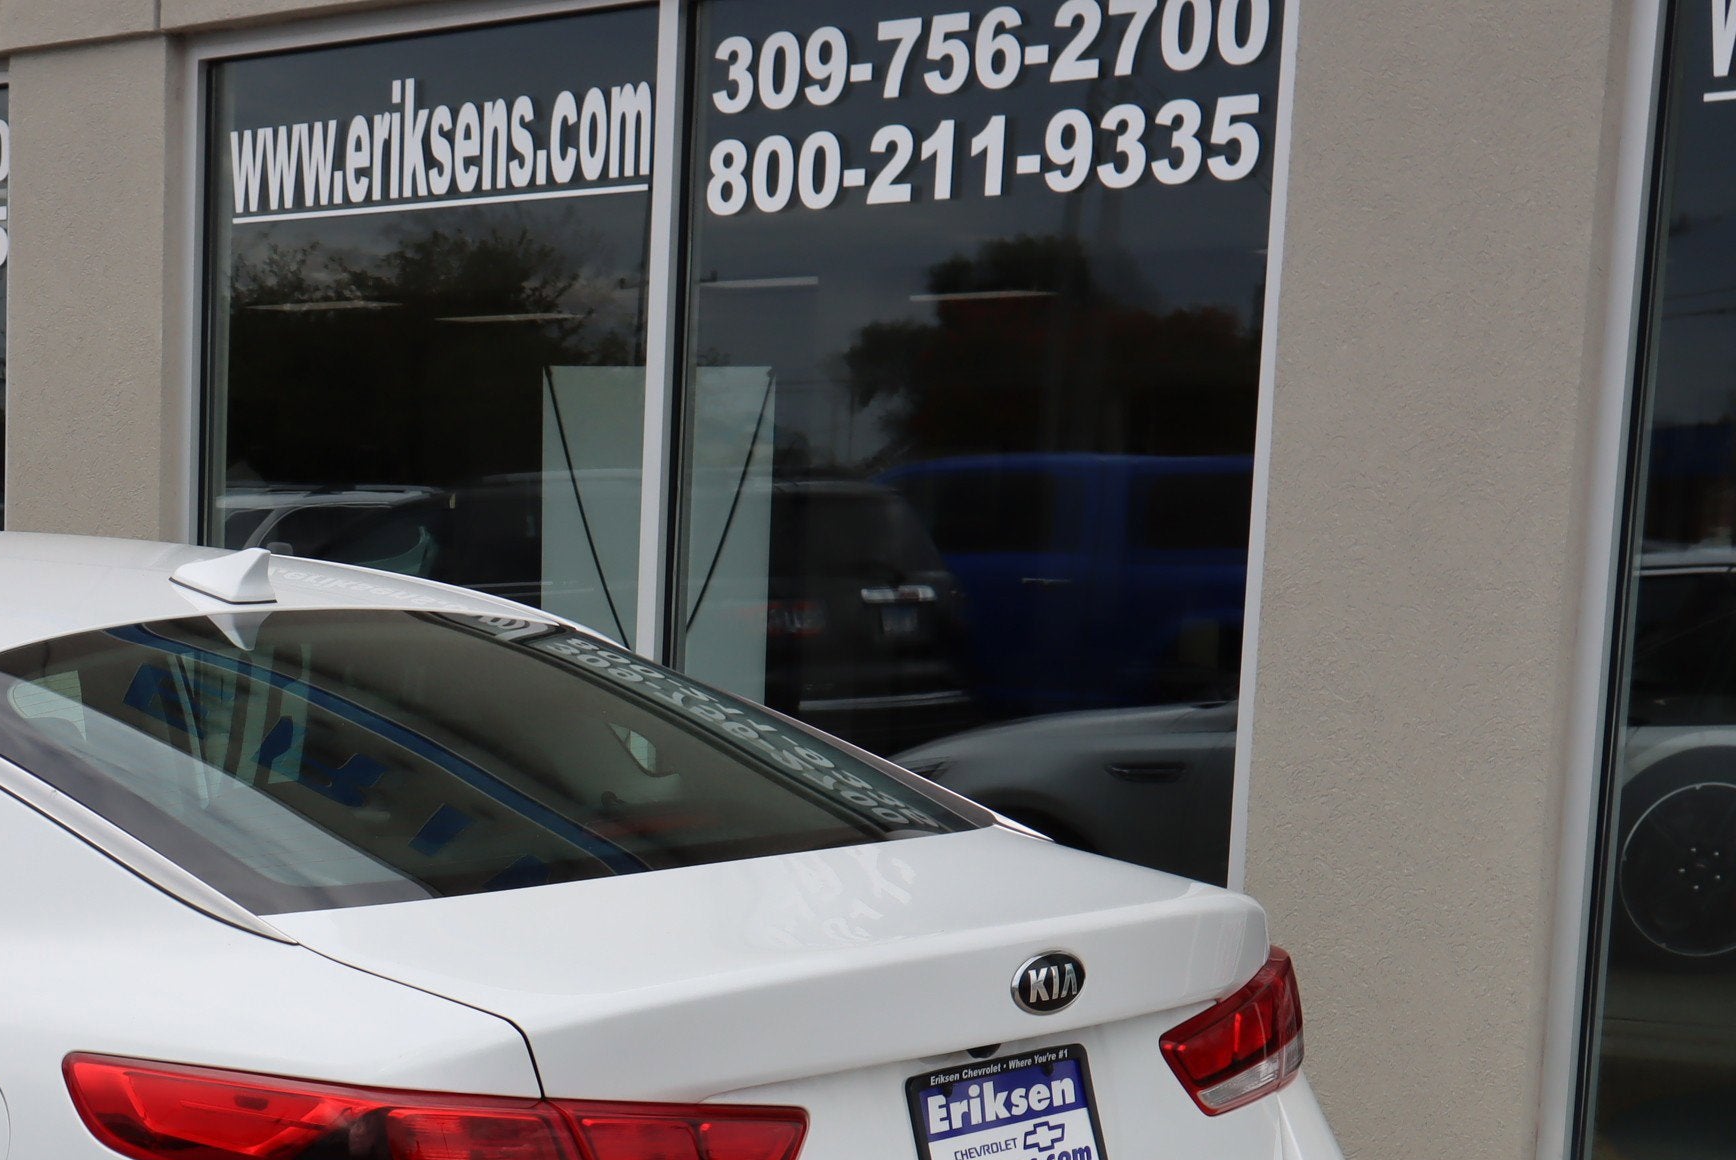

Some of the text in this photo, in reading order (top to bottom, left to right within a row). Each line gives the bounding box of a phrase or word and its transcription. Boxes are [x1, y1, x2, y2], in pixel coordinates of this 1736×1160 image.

[712, 0, 1270, 114] 309-756-2700
[230, 78, 652, 214] www.eriksens.com
[706, 94, 1260, 216] 800-211-9335
[1028, 963, 1078, 1003] KIA
[927, 1077, 1076, 1135] Eriksen
[930, 1049, 1069, 1087] Eriksen Chevrolet Where You're #1
